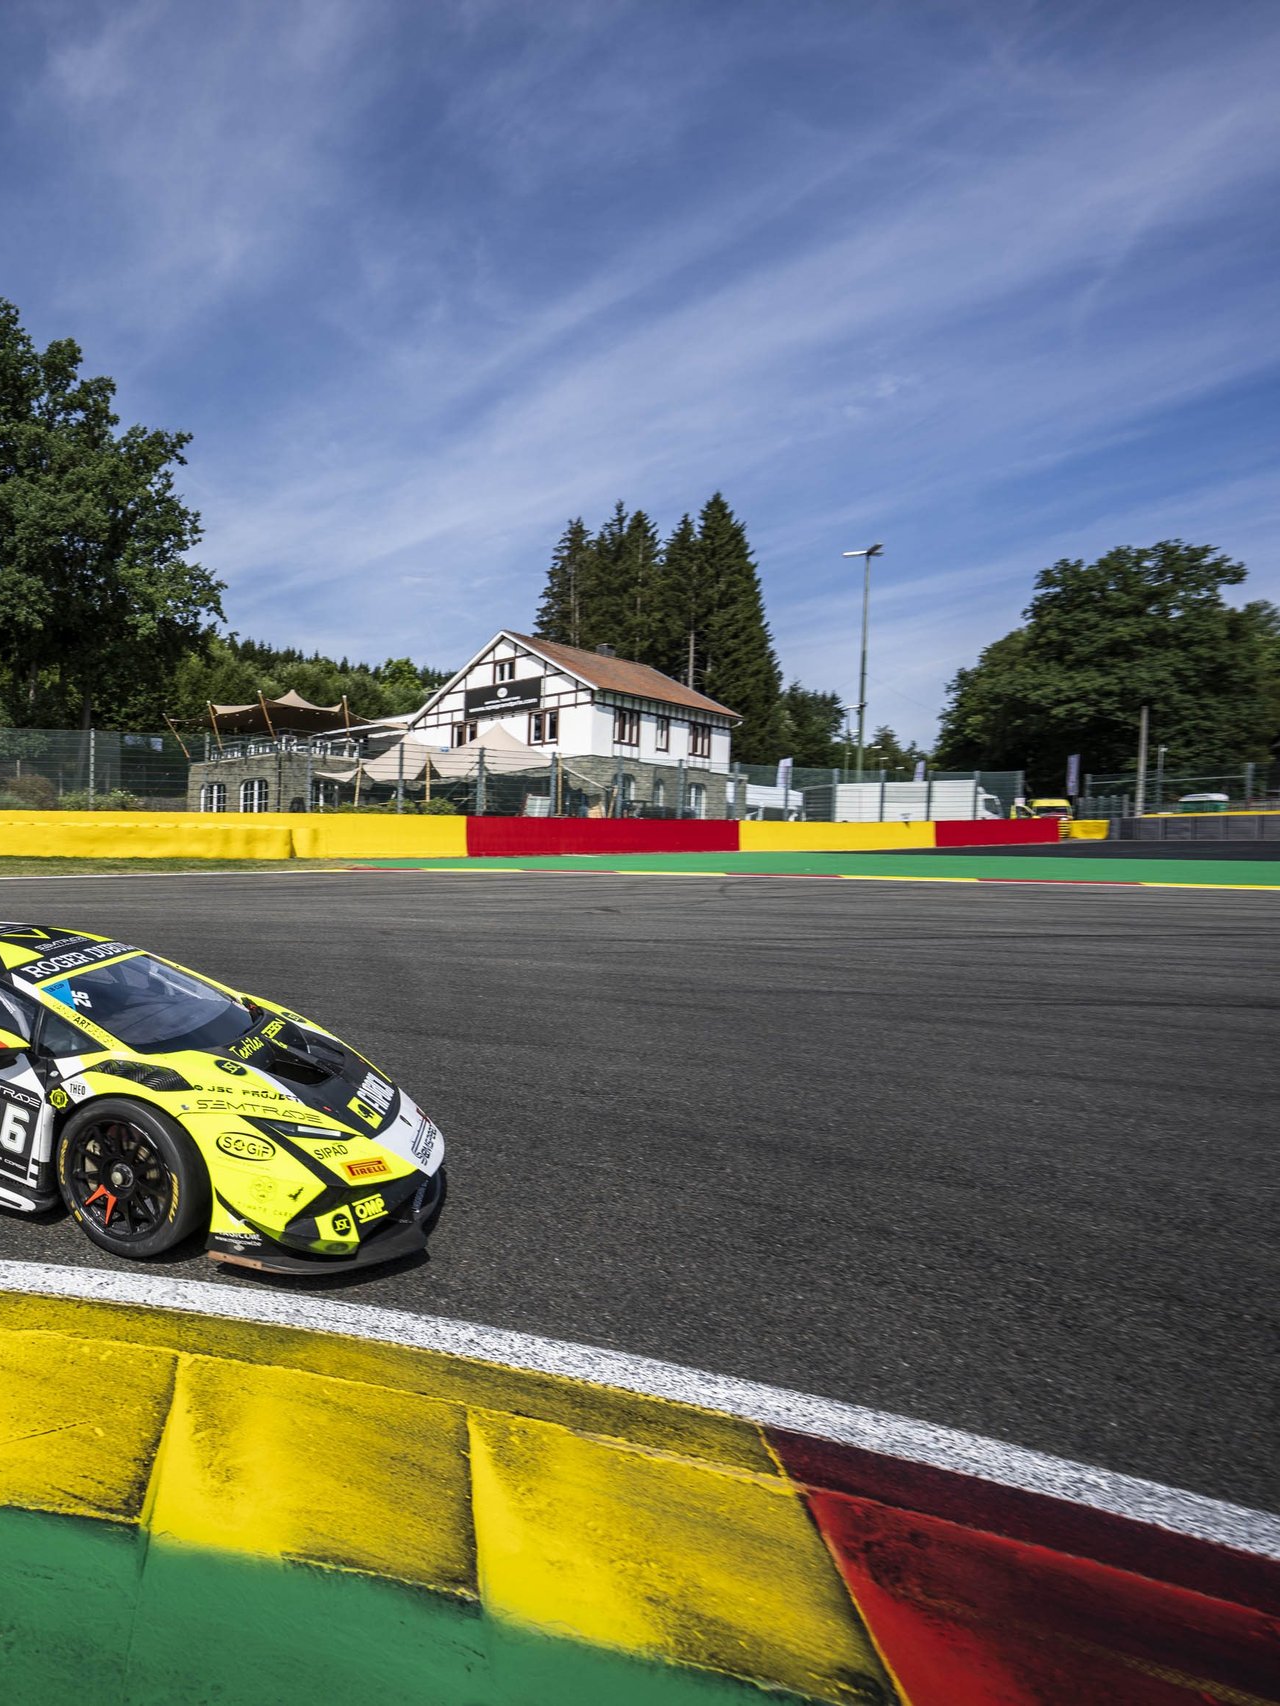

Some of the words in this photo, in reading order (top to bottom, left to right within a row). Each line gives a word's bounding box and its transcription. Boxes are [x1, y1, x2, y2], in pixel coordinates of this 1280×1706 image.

[21, 950, 87, 979] ROGER
[71, 990, 92, 1008] 26
[70, 1083, 86, 1096] THEO
[207, 1086, 233, 1094] JSC
[197, 1099, 323, 1124] SEMTRADE
[314, 1144, 349, 1160] SIPAD
[347, 1160, 387, 1177] PIRELLI
[355, 1197, 385, 1219] OMP
